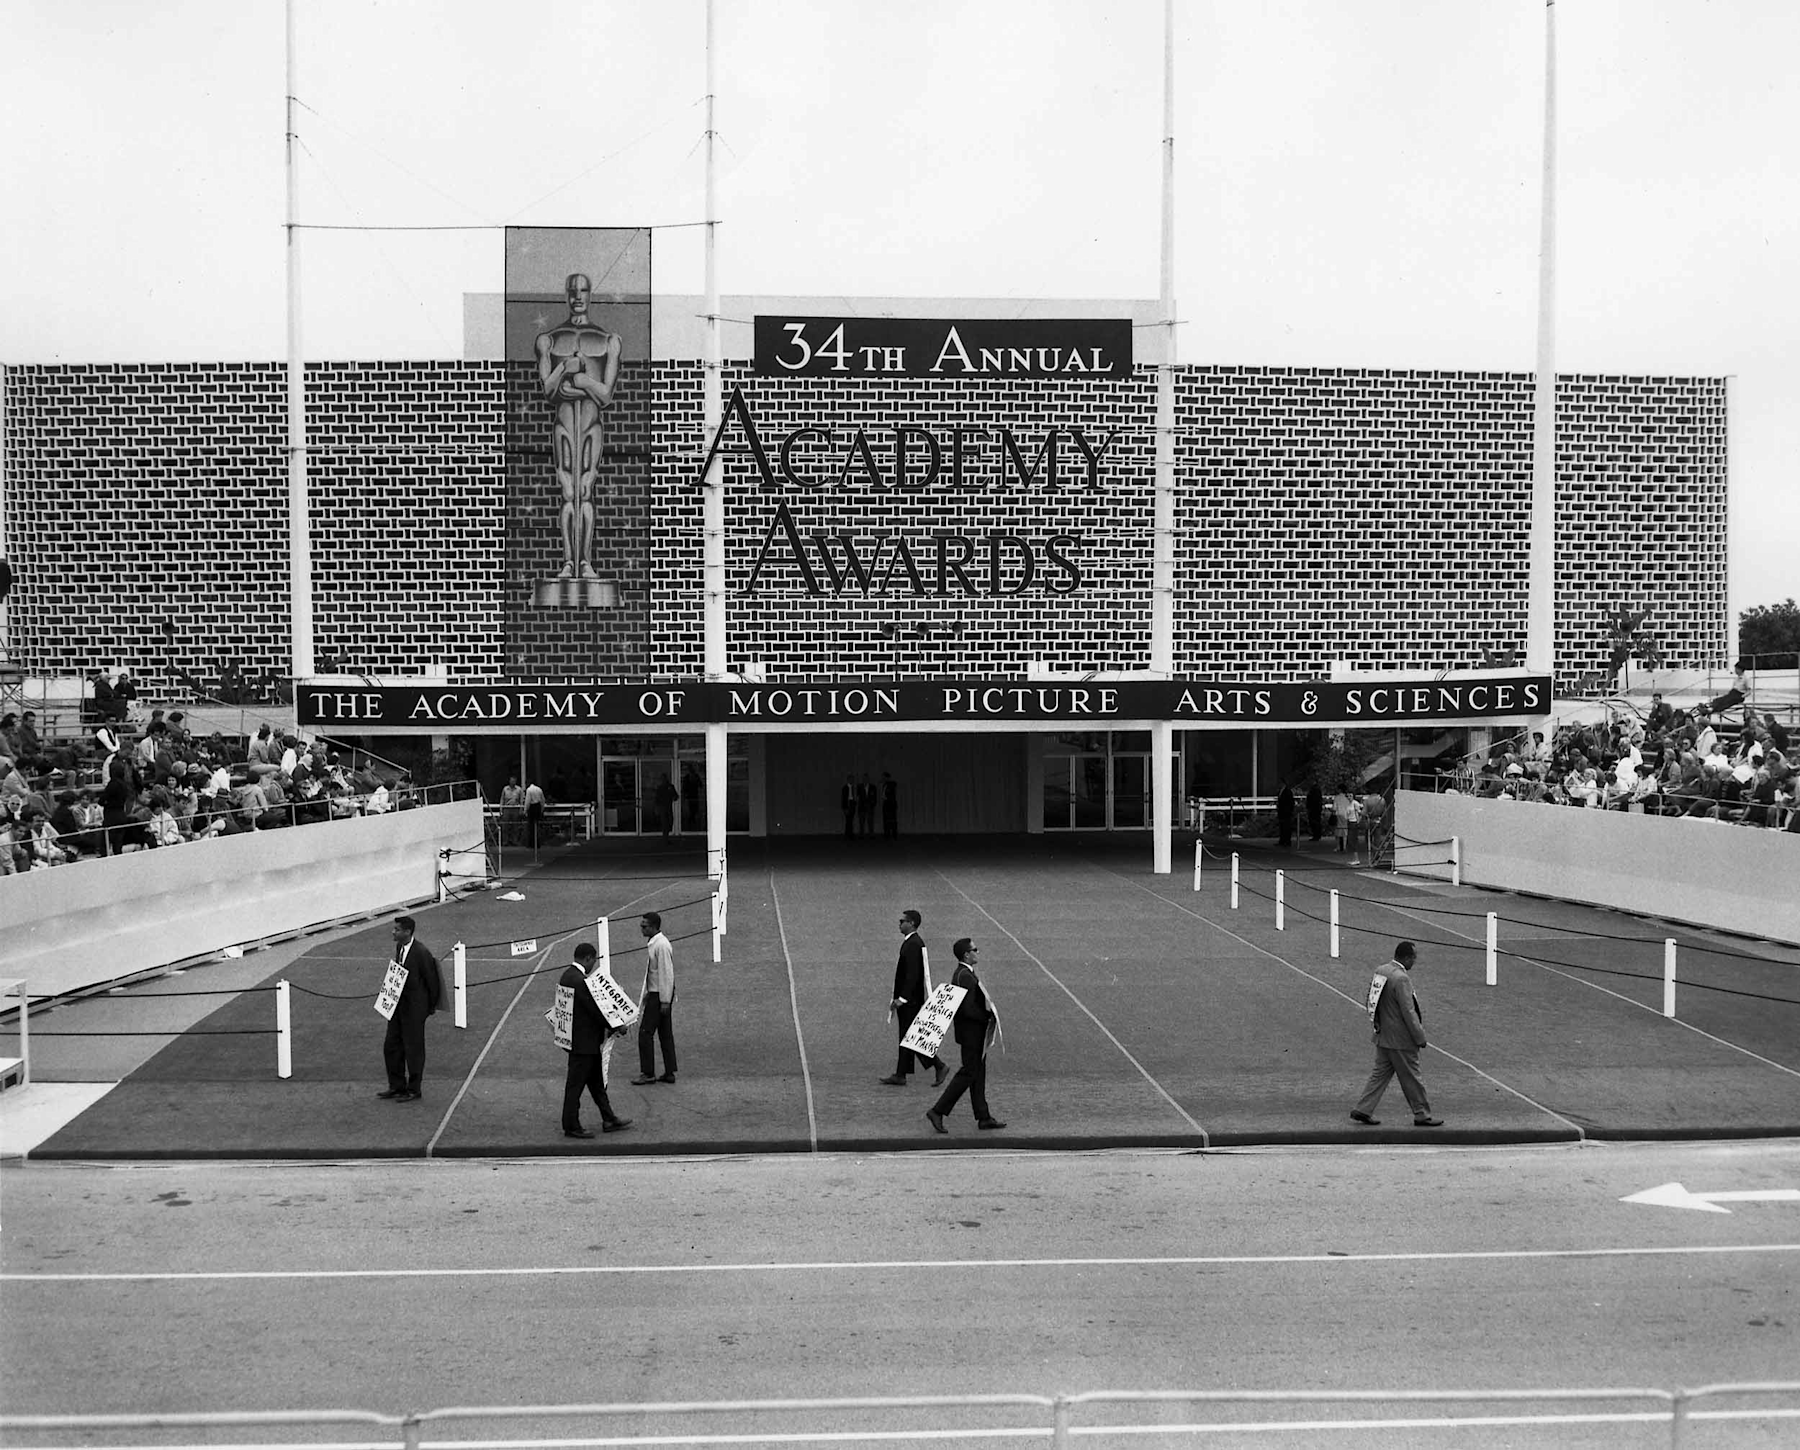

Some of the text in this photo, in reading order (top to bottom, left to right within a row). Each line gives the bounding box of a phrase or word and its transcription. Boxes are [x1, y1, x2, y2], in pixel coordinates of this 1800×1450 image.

[776, 323, 1113, 371] 34TH ANNUAL
[691, 383, 1122, 490] ACADEMY
[736, 498, 1083, 597] AWARDS
[311, 684, 1540, 718] THE ACADEMY OF MOTION PICTURE ARTS & SCIENCES
[596, 973, 634, 1016] INTEGRATED
[935, 990, 954, 1001] YOUTH
[944, 984, 954, 992] THE
[925, 1001, 953, 1020] AMERICA
[928, 1013, 937, 1021] IS
[917, 1027, 932, 1038] WITH
